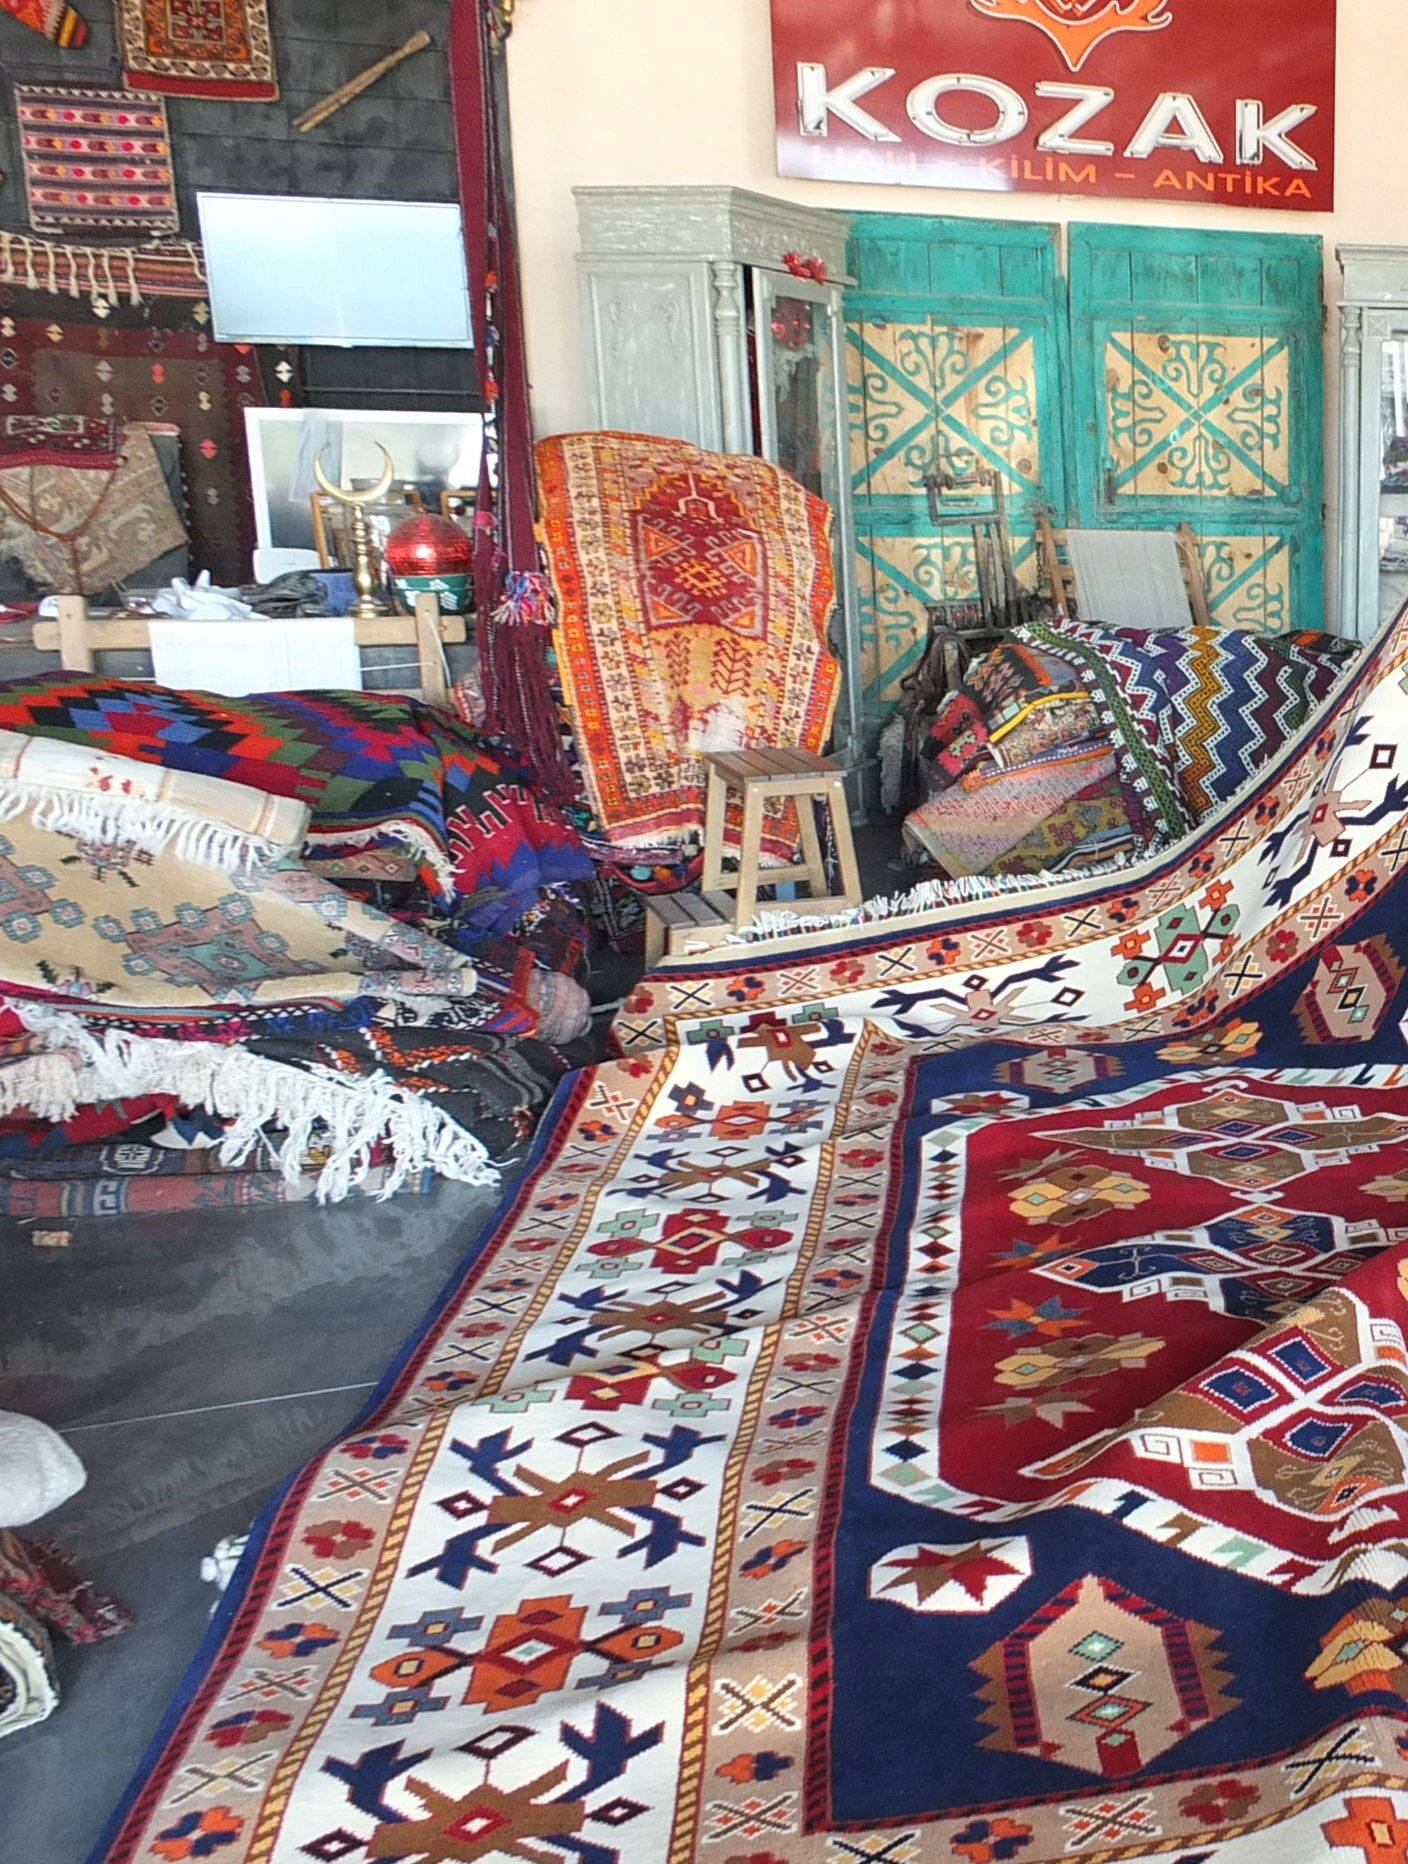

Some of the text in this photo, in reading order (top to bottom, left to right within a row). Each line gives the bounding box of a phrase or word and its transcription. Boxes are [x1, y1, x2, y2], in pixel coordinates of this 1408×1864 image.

[796, 62, 1318, 170] KOZAK
[810, 145, 918, 171] HALI
[979, 154, 1097, 184] KİLİM
[1152, 169, 1312, 198] ANTİKA
